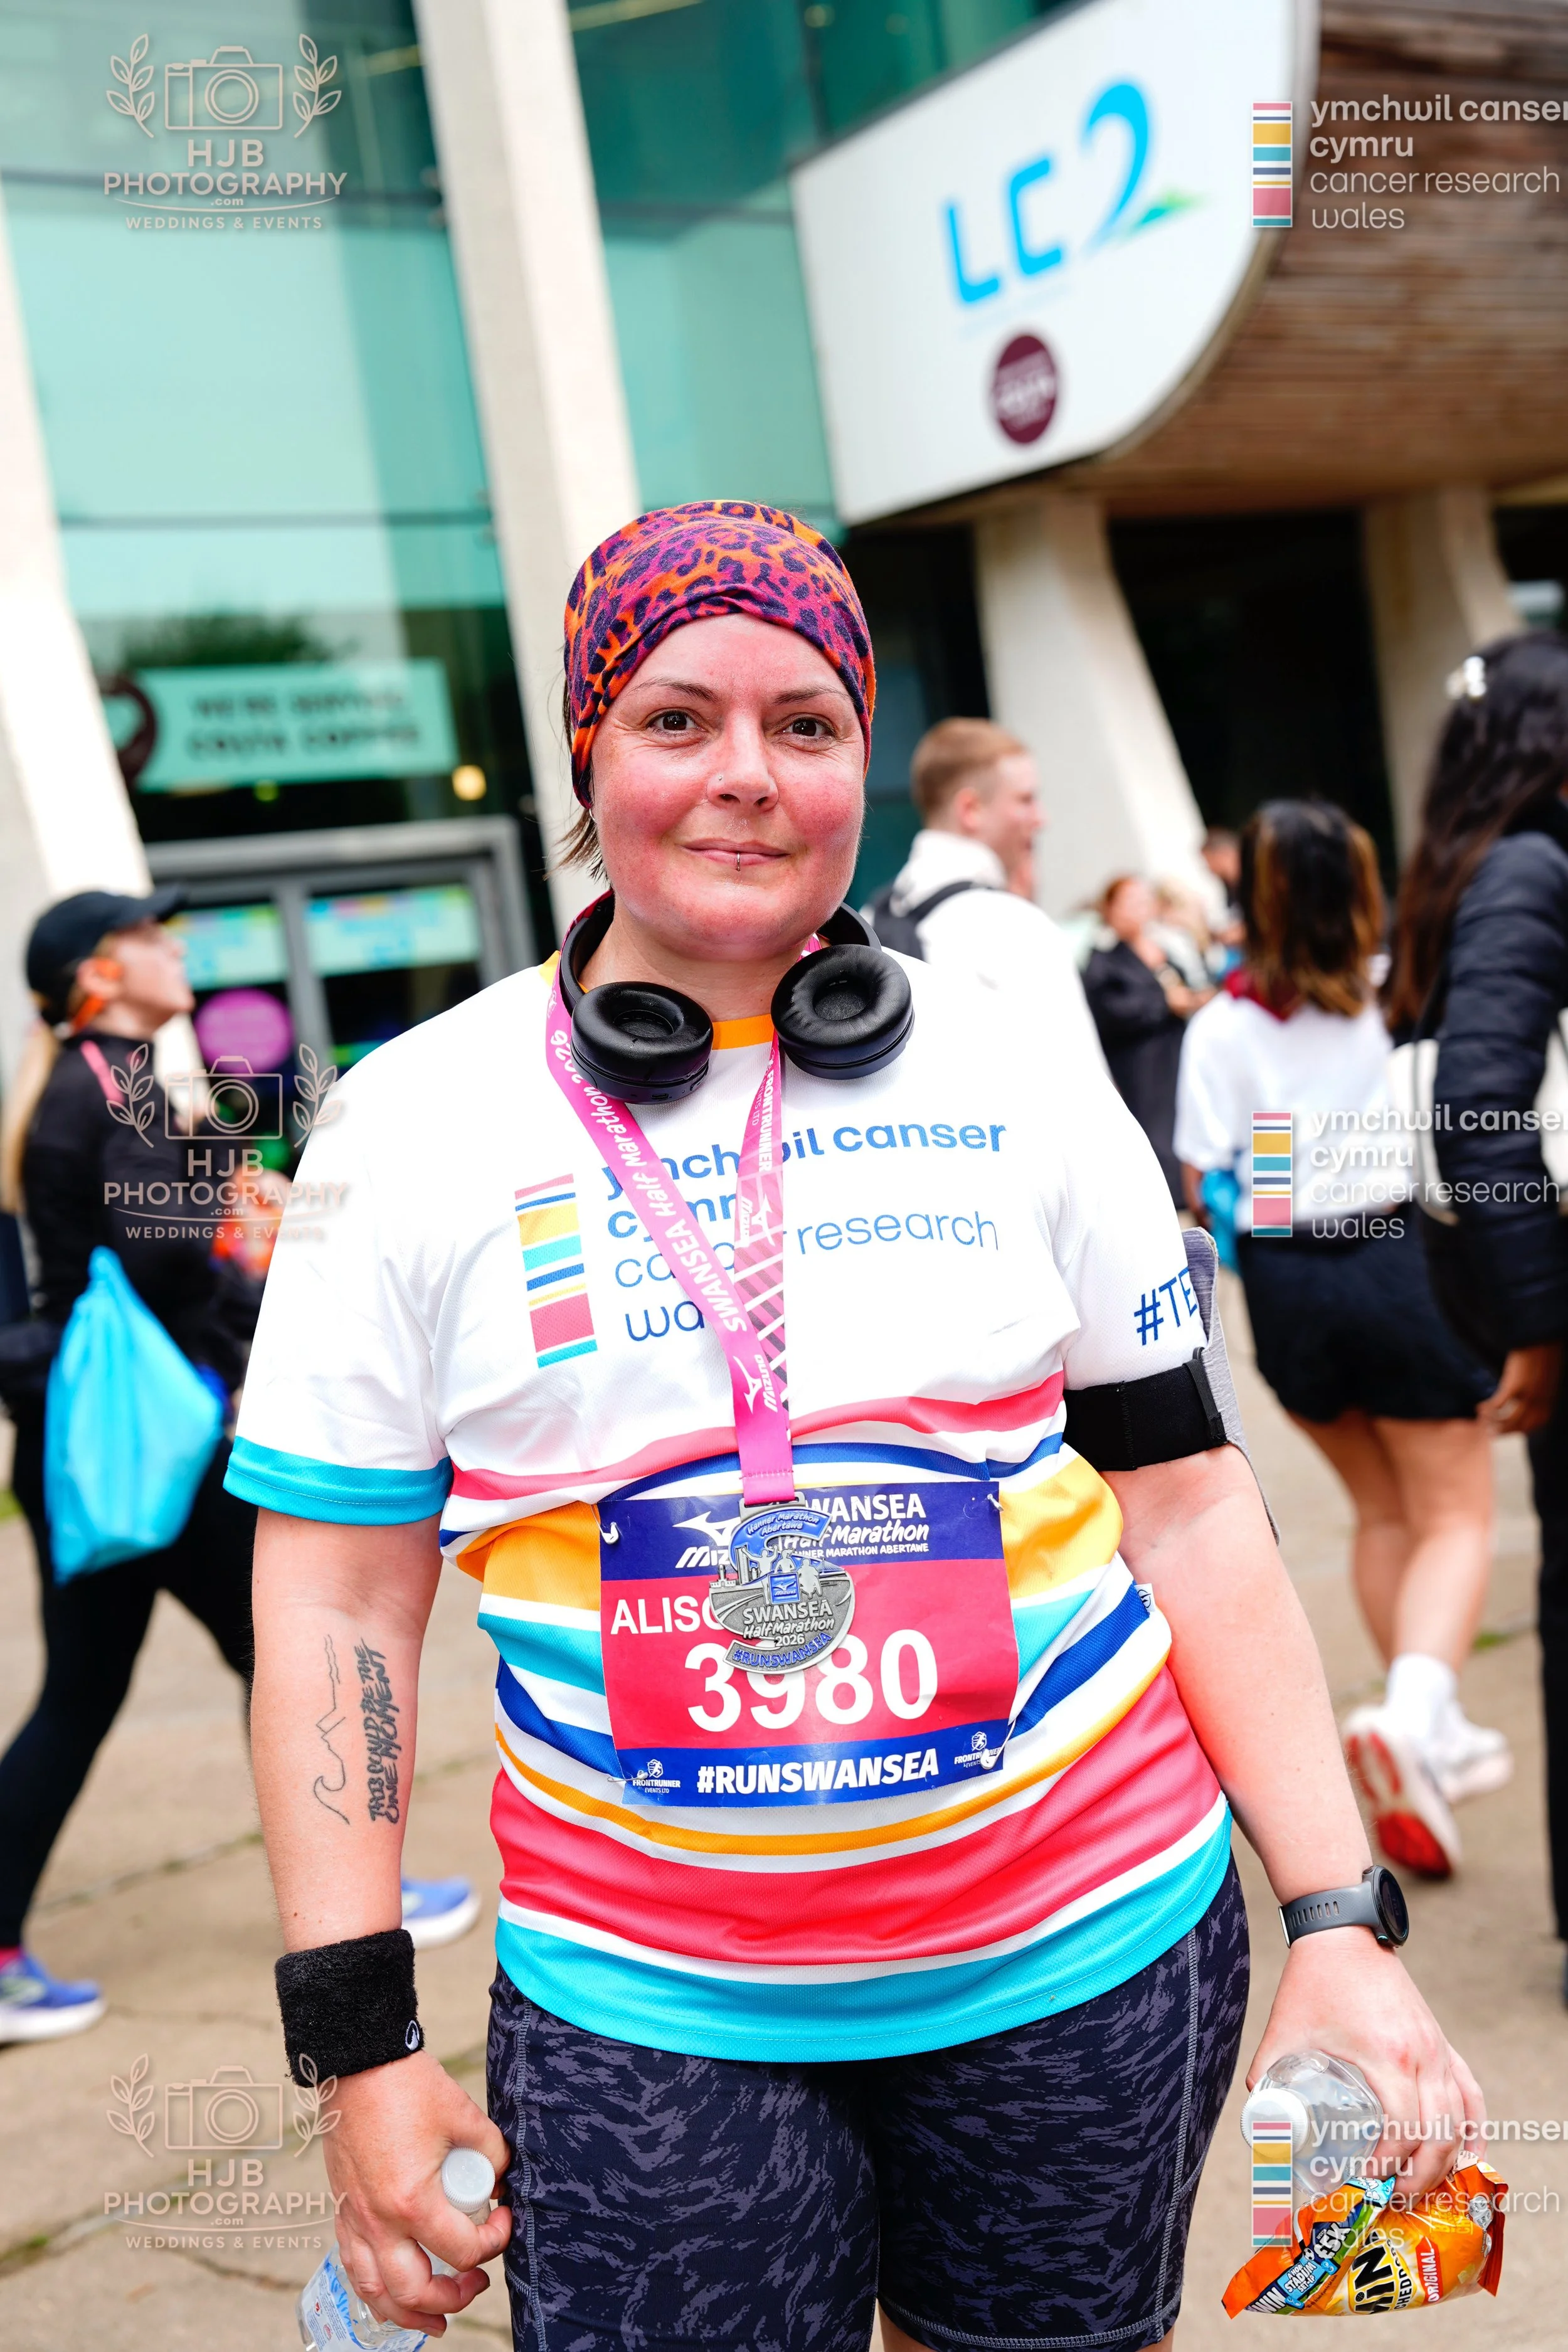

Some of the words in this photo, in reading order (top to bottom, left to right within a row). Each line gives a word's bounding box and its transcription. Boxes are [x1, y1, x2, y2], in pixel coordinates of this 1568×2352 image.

[584, 1086, 648, 1167] Marathon
[758, 1068, 774, 1172] FRONTRUNNER
[833, 1124, 1006, 1153] canser
[632, 1172, 677, 1217] Half
[797, 1210, 999, 1255] research
[665, 1218, 748, 1332] SWANSEA
[747, 1515, 776, 1535] Hanner
[776, 1512, 820, 1525] Marathon
[801, 1493, 926, 1523] WANSEA
[761, 1521, 803, 1536] Abertawe
[831, 1519, 930, 1548] Marathon
[825, 1545, 879, 1558] MARATHON
[880, 1542, 930, 1555] ABERTAWE
[743, 1601, 834, 1624] SWANSEA
[733, 1631, 833, 1668] #RUNSWANSEA
[775, 1634, 805, 1648] 2026
[354, 1645, 374, 1683] THE
[684, 1629, 939, 1732] 3980
[359, 1683, 376, 1714] BE
[361, 1638, 402, 1760] MOMENT
[363, 1715, 384, 1774] COULD
[632, 1779, 681, 1788] FRONTRUNNER
[697, 1747, 940, 1795] #RUNSWANSEA
[384, 1763, 400, 1825] ONE
[1313, 2222, 1352, 2259] £5K
[1420, 2248, 1441, 2303] ORIGINAL
[1249, 2287, 1286, 2314] WIN
